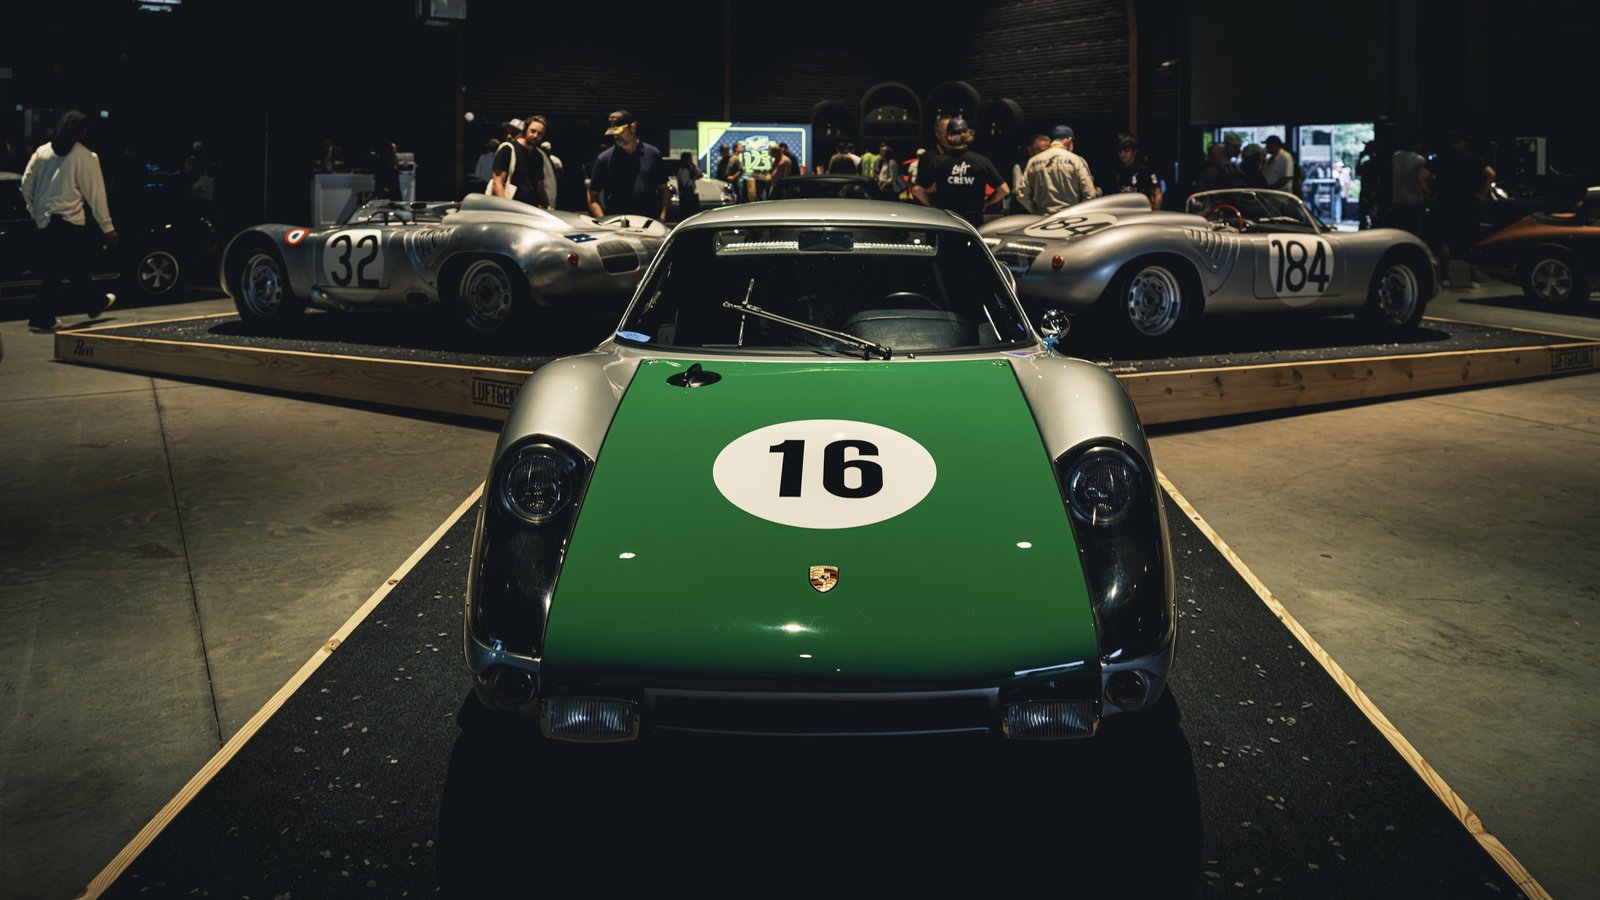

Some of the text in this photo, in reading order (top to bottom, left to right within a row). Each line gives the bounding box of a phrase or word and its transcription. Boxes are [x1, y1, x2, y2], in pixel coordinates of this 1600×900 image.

[947, 176, 975, 185] CREW
[330, 234, 380, 289] 32
[1271, 239, 1330, 293] 184
[769, 439, 883, 499] 16
